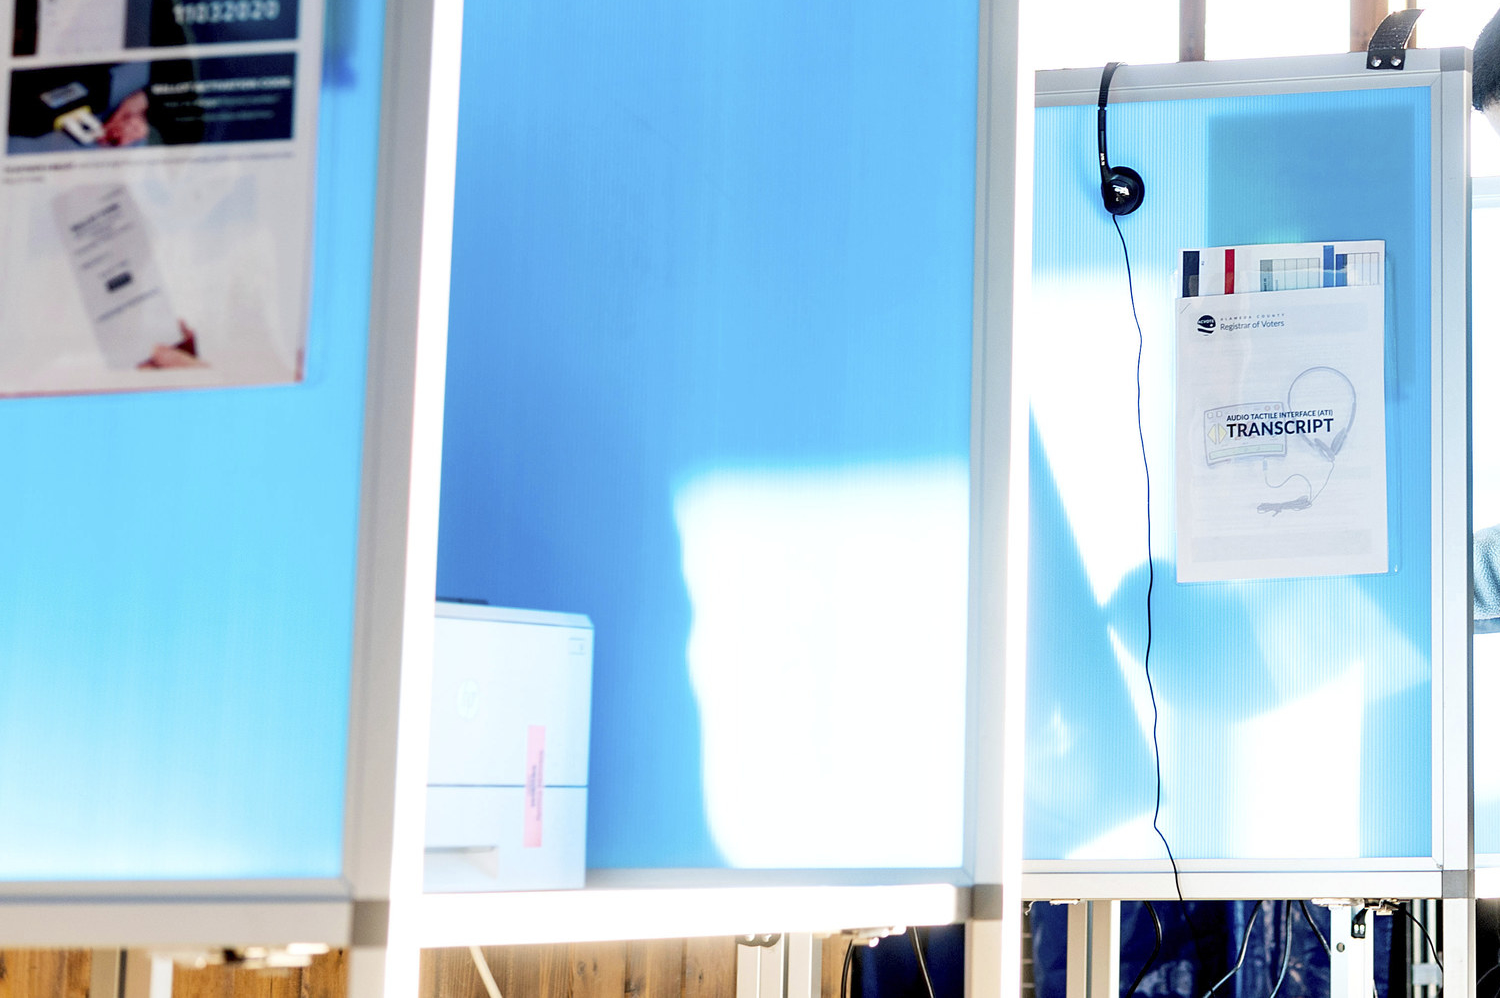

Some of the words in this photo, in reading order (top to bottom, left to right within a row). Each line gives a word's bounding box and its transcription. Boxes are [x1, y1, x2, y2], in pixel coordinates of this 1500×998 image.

[1220, 322, 1251, 331] Registrar
[1251, 412, 1277, 420] TACTILE
[1279, 410, 1316, 418] INTERFACE
[1317, 409, 1333, 417] (ATI)
[1226, 418, 1334, 438] TRANSCRIPT
